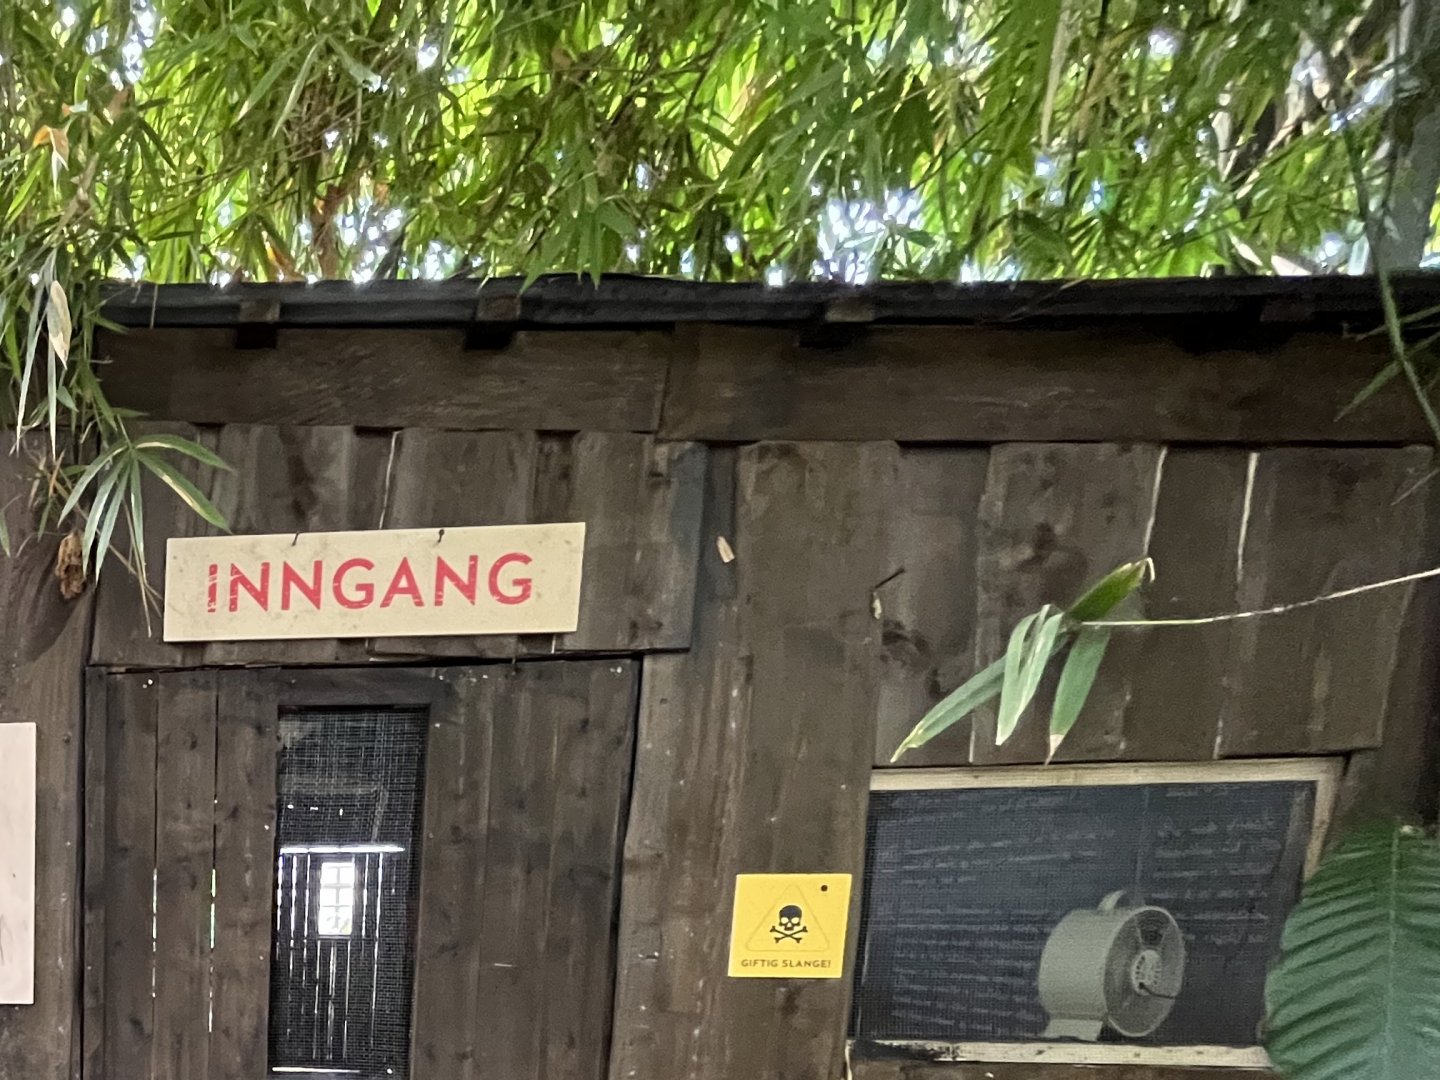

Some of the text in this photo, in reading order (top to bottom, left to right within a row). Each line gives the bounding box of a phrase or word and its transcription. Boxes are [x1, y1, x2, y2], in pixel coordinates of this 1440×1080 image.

[207, 551, 534, 614] INNGANG
[740, 958, 832, 969] GIFTIG SLANGE!
